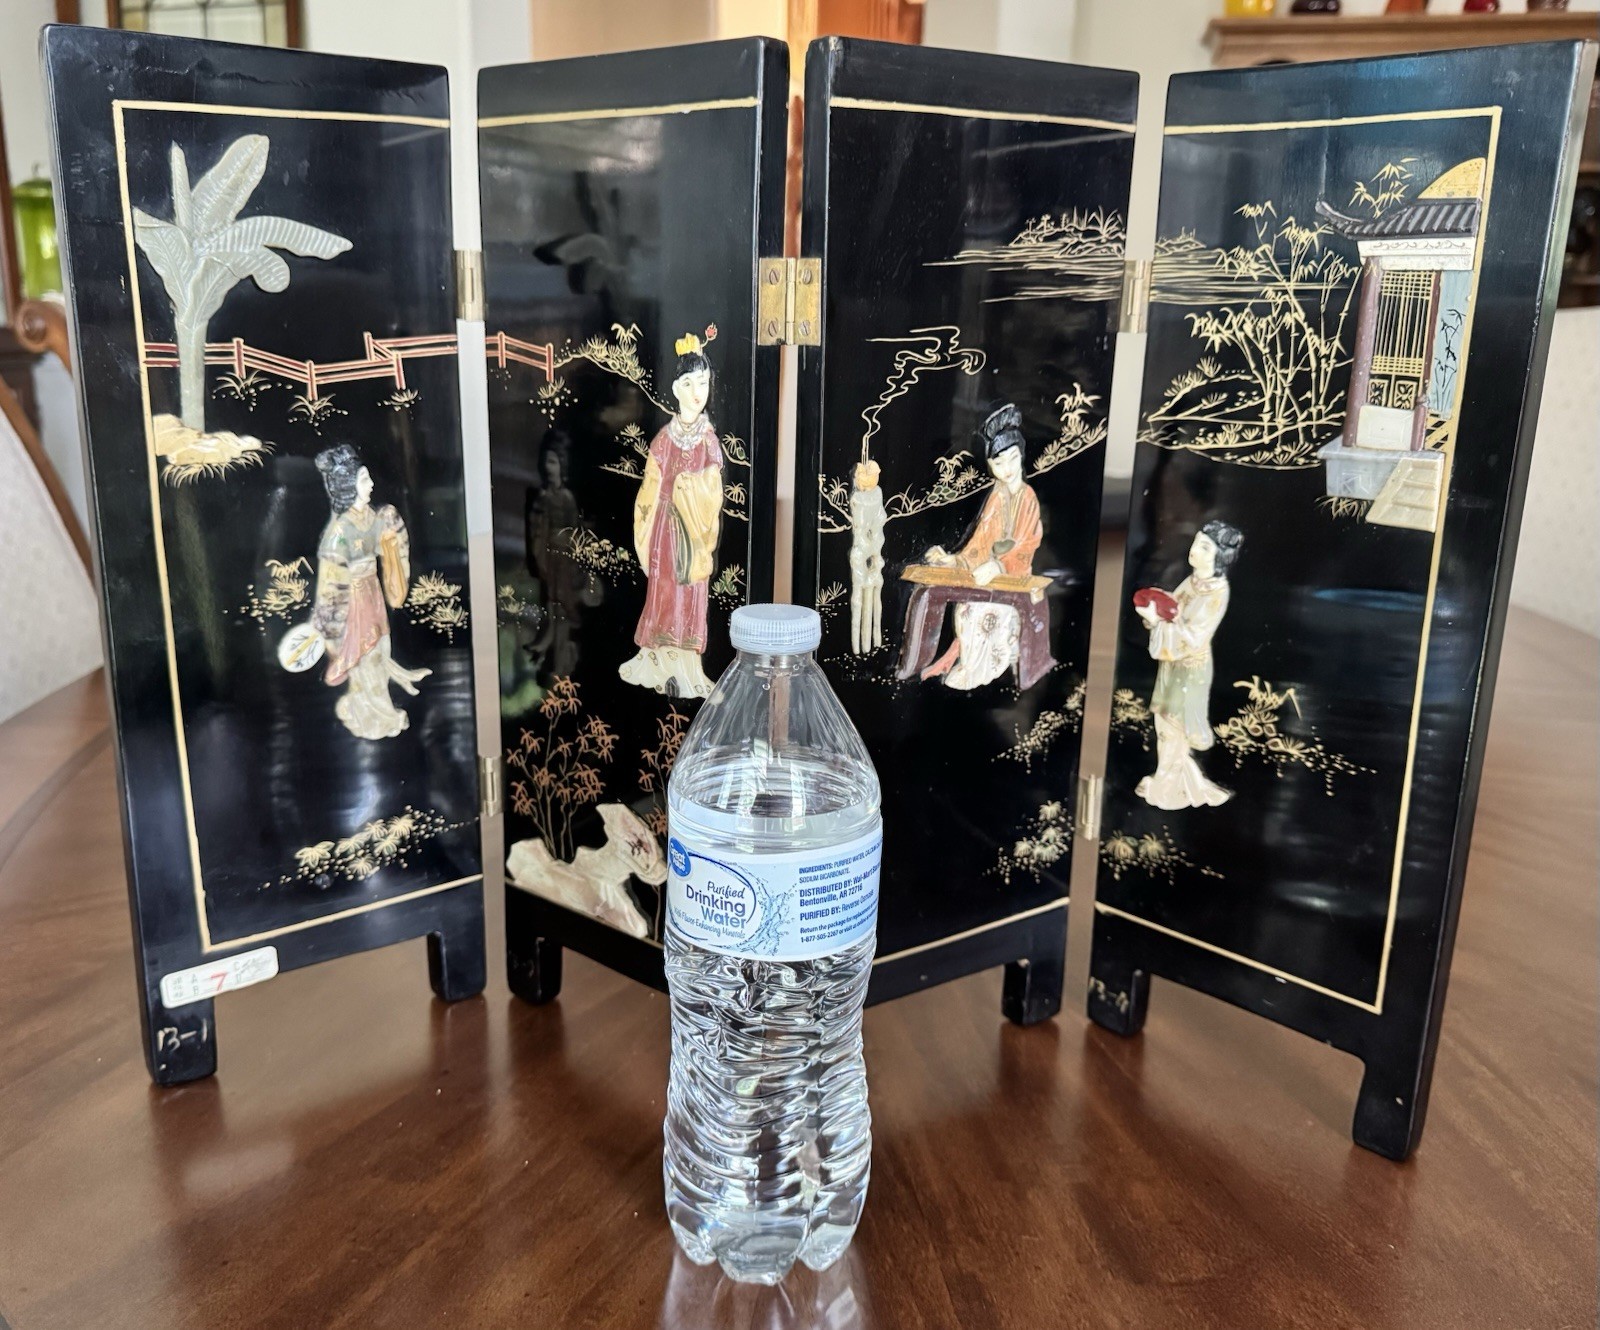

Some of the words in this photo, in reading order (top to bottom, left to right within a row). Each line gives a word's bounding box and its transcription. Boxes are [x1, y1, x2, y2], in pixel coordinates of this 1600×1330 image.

[799, 862, 833, 874] INGREDIENTS:
[834, 856, 852, 868] PURIFIED
[799, 875, 818, 883] SODIUM
[800, 882, 843, 897] DISTRIBUTED
[843, 879, 852, 888] BY:
[853, 870, 872, 884] Wal-Mart
[707, 881, 746, 899] Purified
[800, 894, 838, 907] Bentonville,
[839, 890, 848, 899] AR
[686, 884, 746, 917] Drinking
[701, 905, 746, 928] Water
[800, 909, 830, 921] PURIFIED
[831, 906, 841, 915] BY:
[842, 900, 859, 911] Reverse
[800, 925, 818, 934] Return
[828, 918, 846, 930] package
